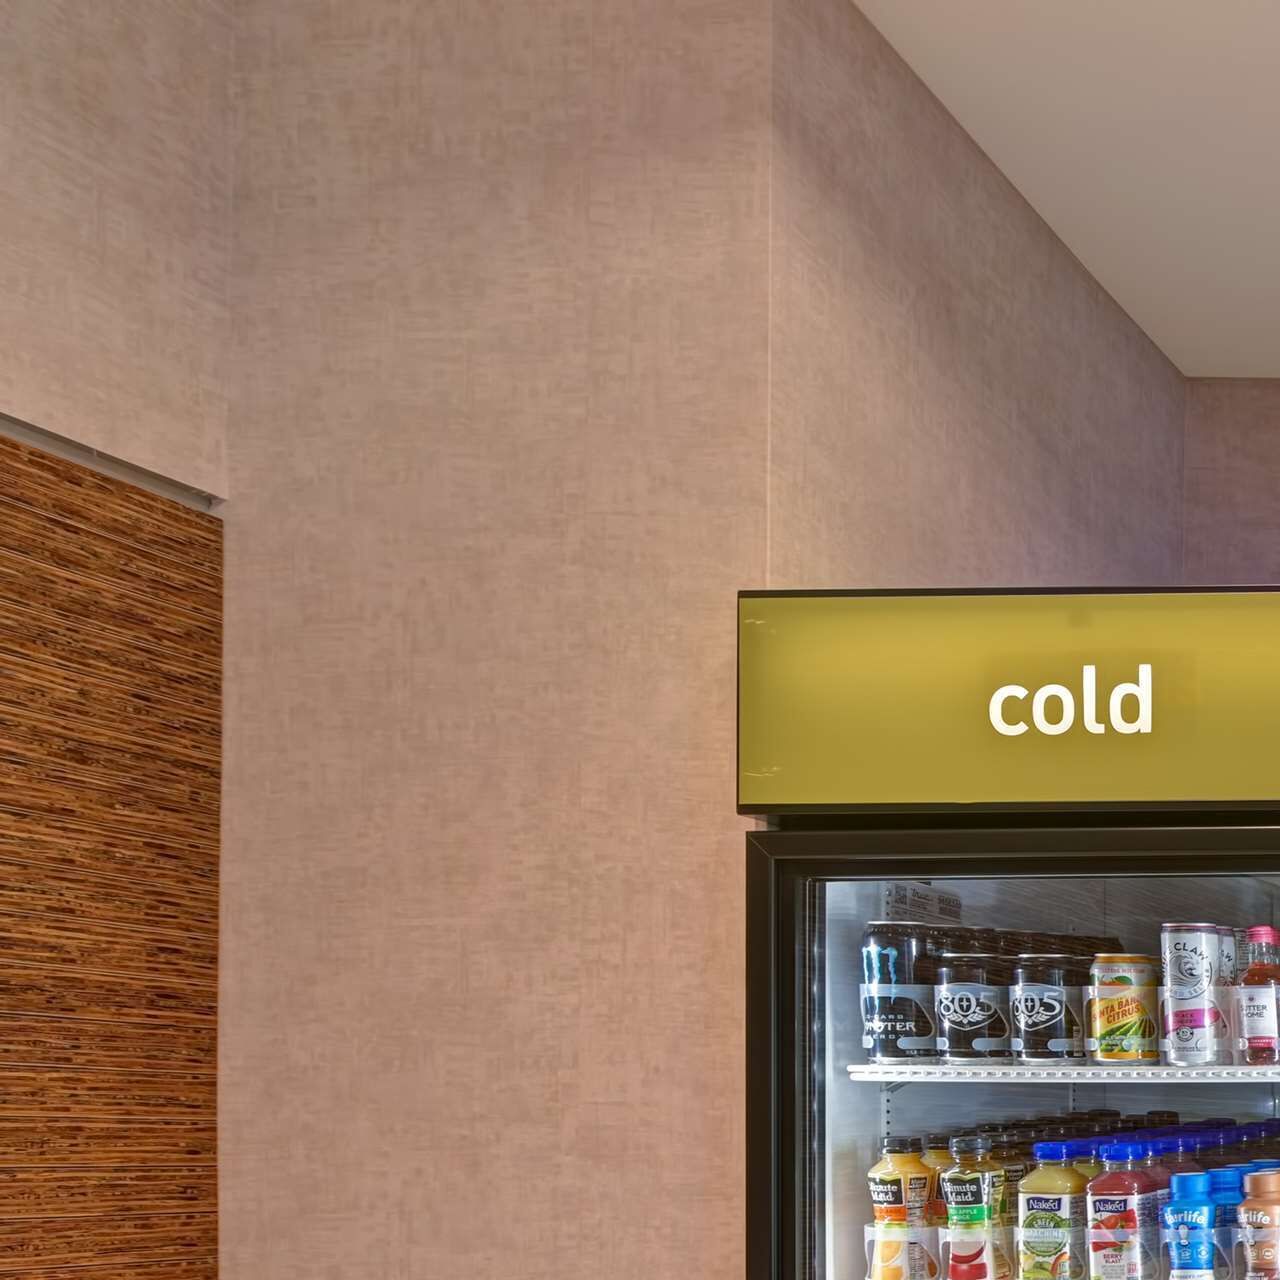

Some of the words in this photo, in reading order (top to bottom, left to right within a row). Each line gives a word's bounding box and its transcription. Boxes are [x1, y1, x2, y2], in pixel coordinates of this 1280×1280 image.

[988, 664, 1153, 736] cold
[939, 991, 995, 1016] 805
[1013, 991, 1061, 1016] 805
[1106, 1003, 1141, 1025] CITRUS
[944, 1182, 978, 1192] Minute
[948, 1192, 975, 1202] Maid
[1028, 1199, 1060, 1210] Naked
[1095, 1200, 1126, 1212] Naked
